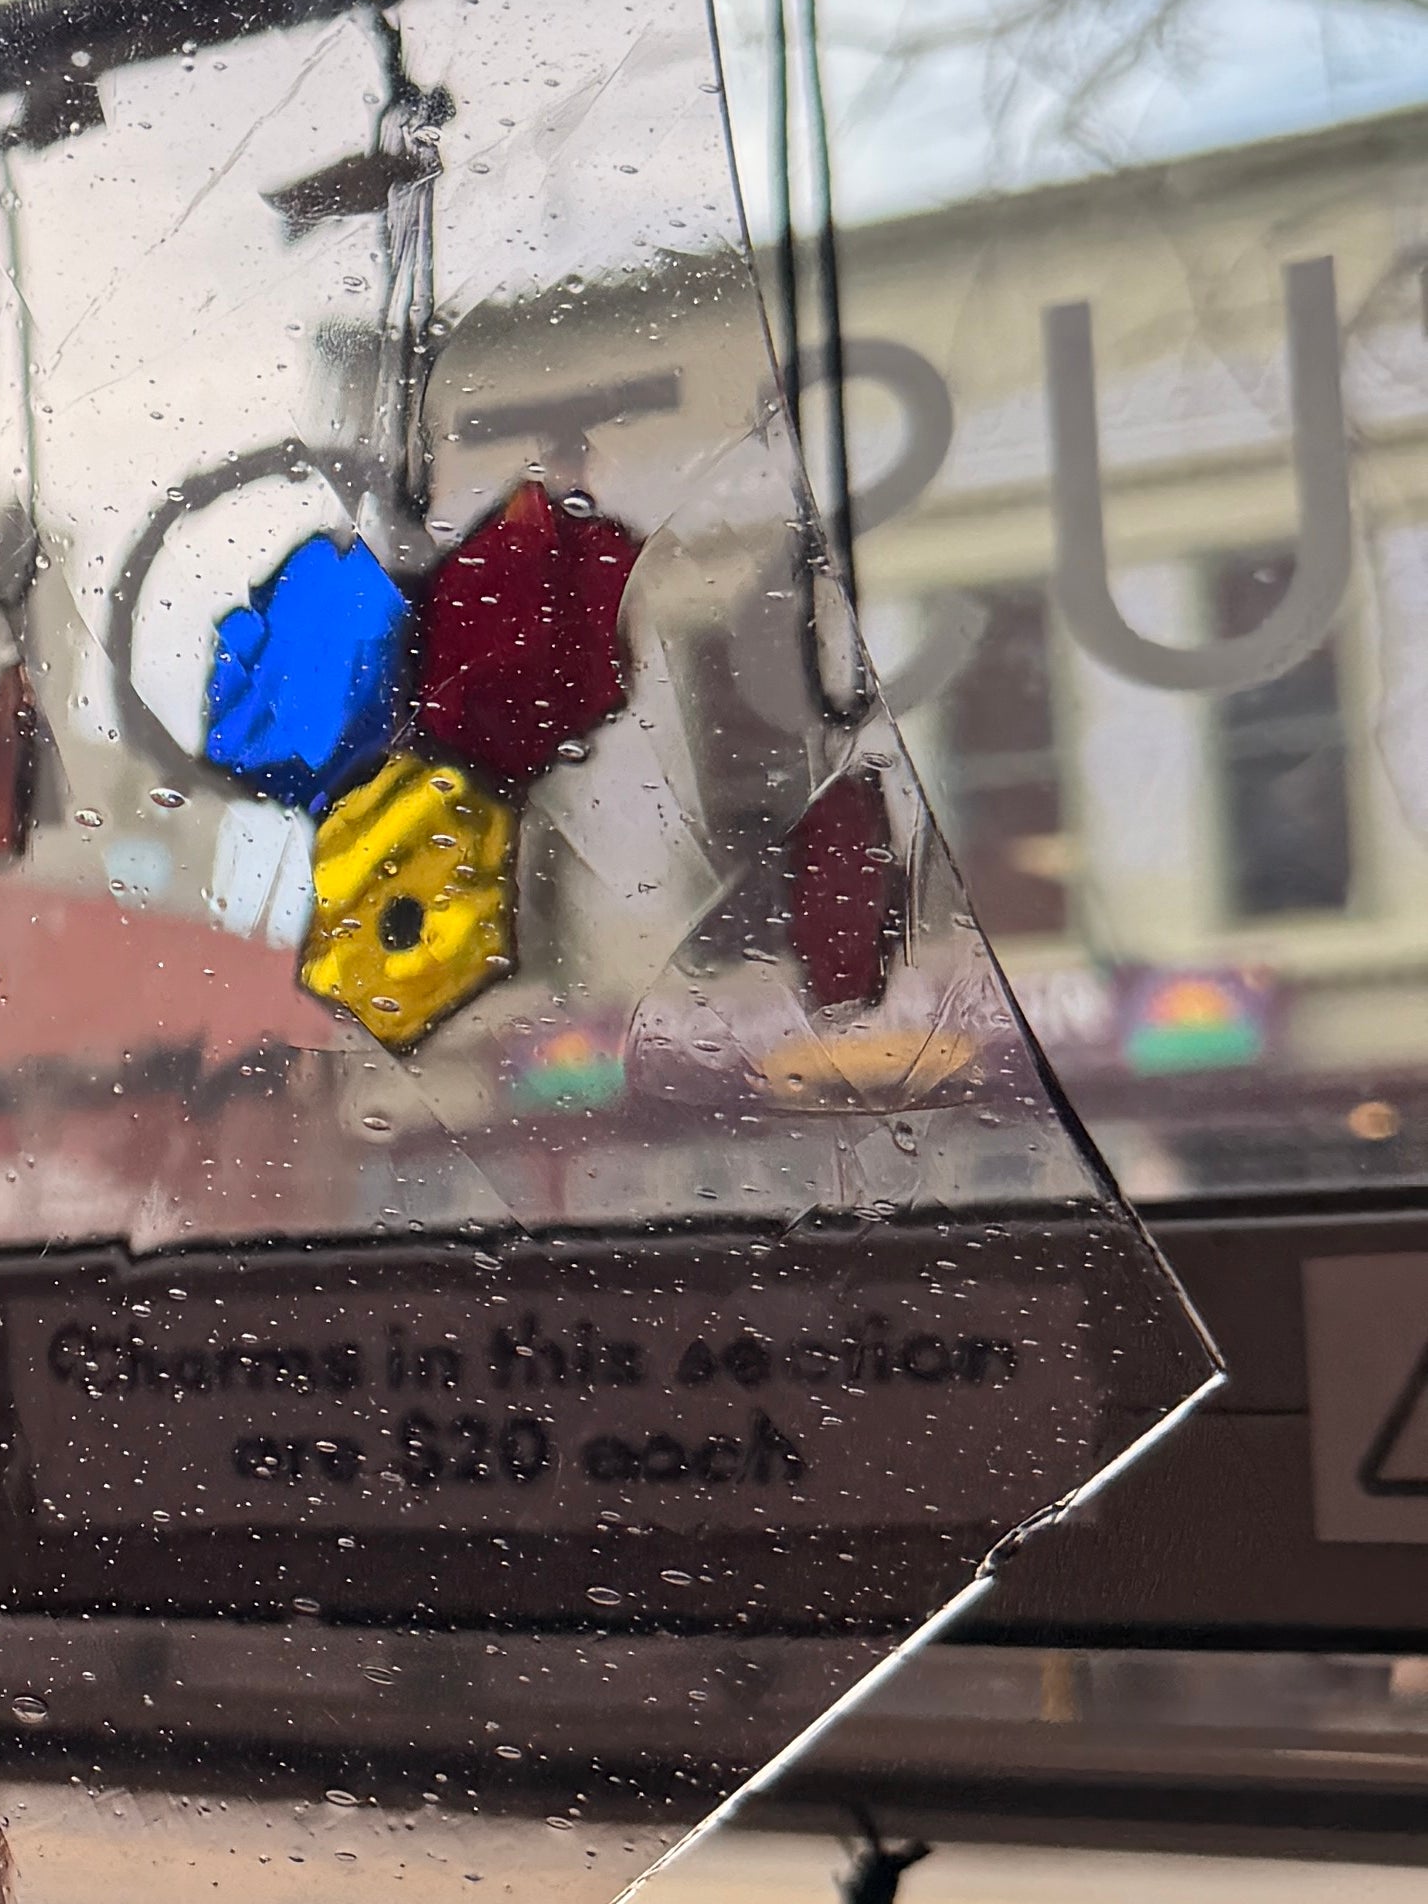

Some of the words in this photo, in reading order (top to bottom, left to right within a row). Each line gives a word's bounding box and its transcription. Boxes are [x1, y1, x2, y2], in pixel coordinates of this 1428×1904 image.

[48, 1319, 361, 1394] Charms
[386, 1322, 461, 1390] in
[489, 1312, 643, 1390] this
[677, 1310, 1019, 1390] section
[232, 1434, 363, 1484] are
[398, 1406, 551, 1488] $20
[580, 1405, 808, 1485] each
